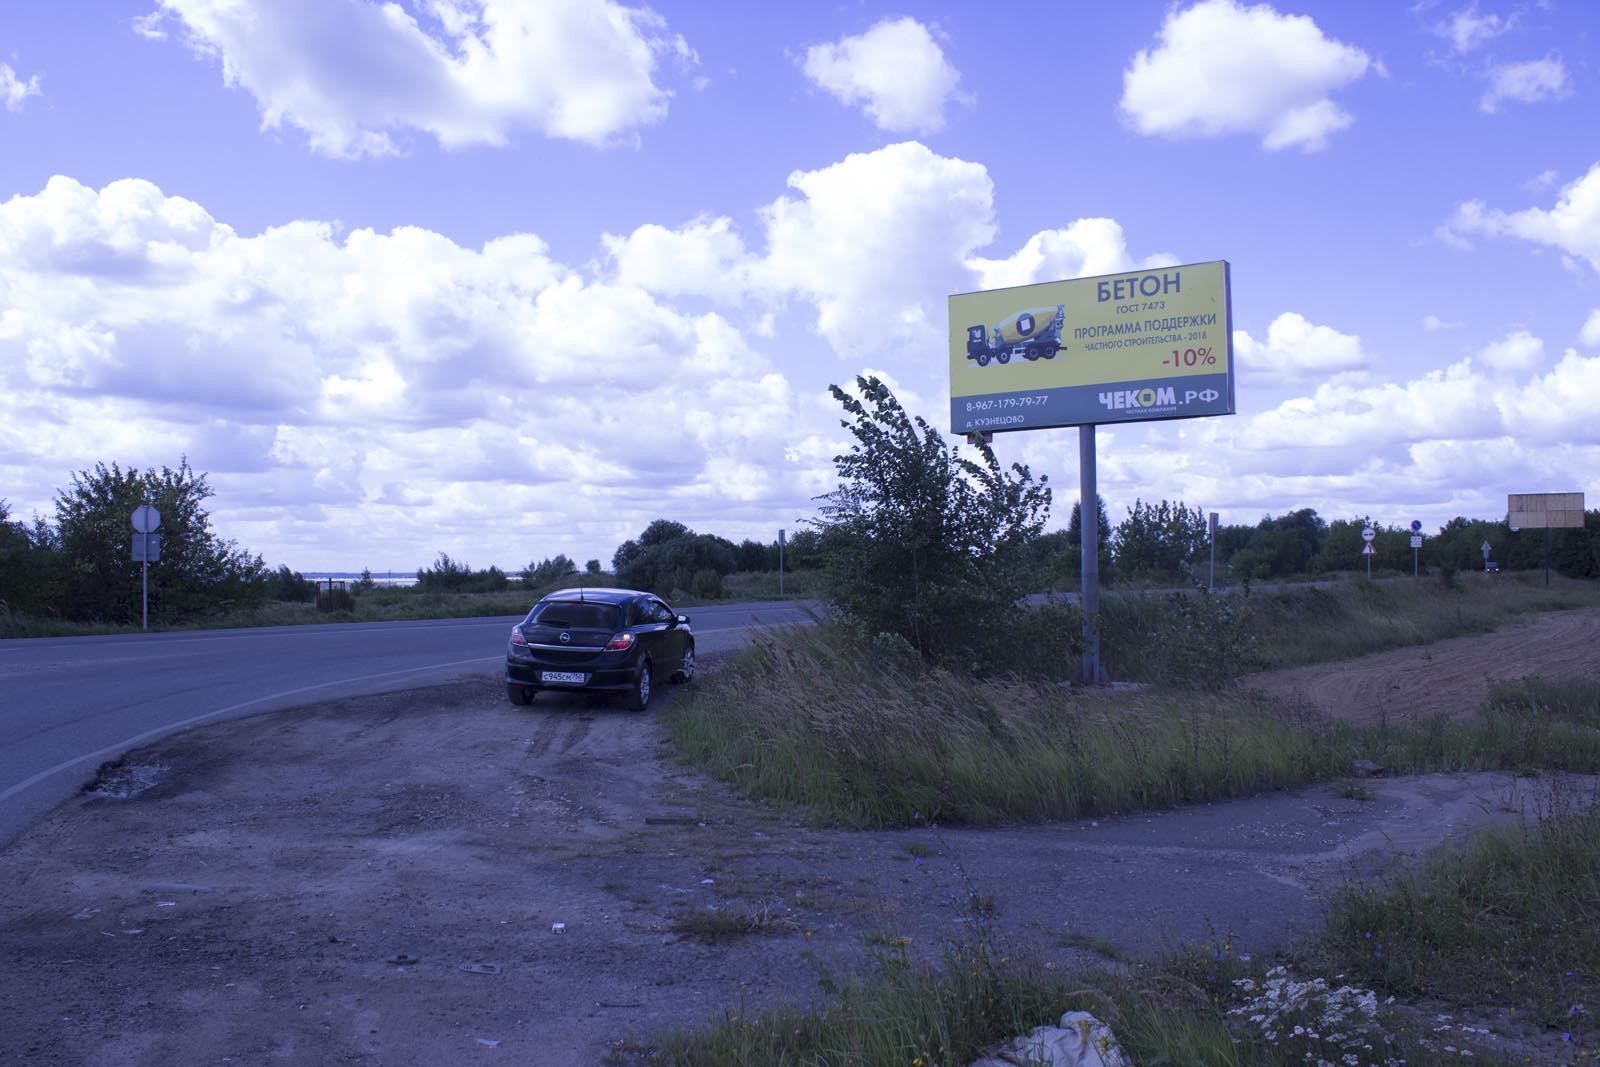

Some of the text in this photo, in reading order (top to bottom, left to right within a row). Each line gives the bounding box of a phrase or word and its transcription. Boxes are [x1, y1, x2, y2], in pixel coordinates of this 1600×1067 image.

[1097, 272, 1181, 303] БЕТОН
[1116, 301, 1166, 314] ГОСТ 7473
[1074, 313, 1216, 339] ПРОГРАММА ПОДДЕРЖКИ
[1084, 340, 1123, 351] ЧАСТНОГО
[1124, 334, 1182, 346] СТРОИТЕЛЬСТВА
[1162, 347, 1217, 367] -10%
[966, 395, 1049, 412] 8-967-179-79-77
[974, 415, 1025, 427] КУЗНЕЦОВО
